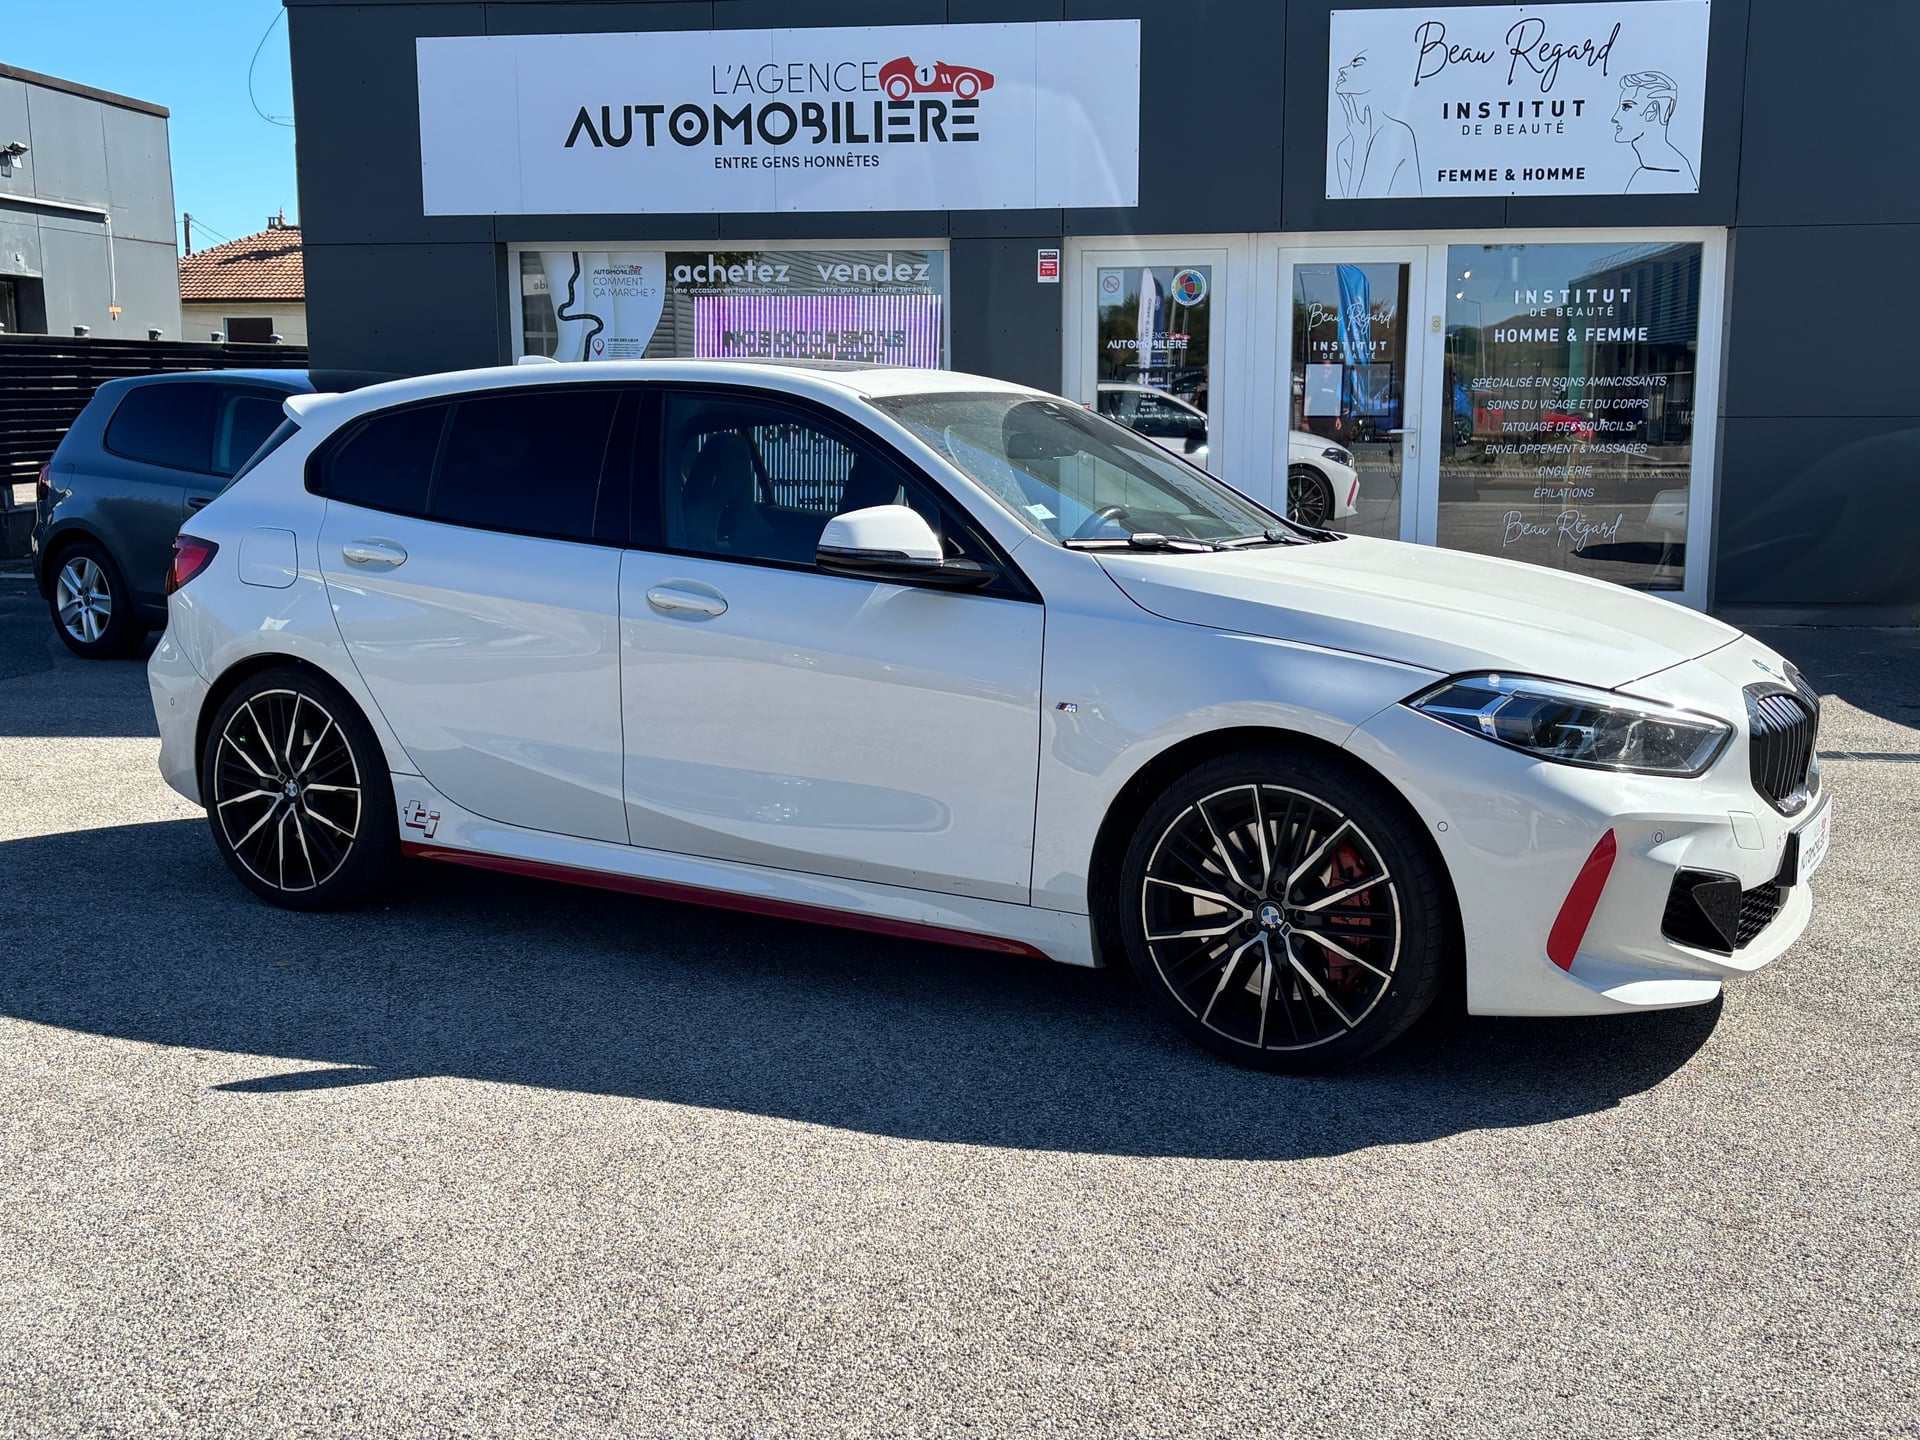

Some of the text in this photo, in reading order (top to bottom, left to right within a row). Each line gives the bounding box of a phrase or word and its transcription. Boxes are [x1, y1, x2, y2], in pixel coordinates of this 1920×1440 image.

[1414, 17, 1621, 93] Beau Regard
[712, 61, 879, 95] L'AGENCE
[921, 67, 928, 82] 1
[1443, 100, 1586, 120] INSTITUT
[1462, 120, 1565, 136] DE BEAUTÉ
[714, 152, 880, 169] ENTRE GENS HONNÊTES
[1437, 167, 1586, 183] FEMME & HOMME
[673, 253, 791, 283] achetez
[816, 252, 931, 282] vendez
[592, 276, 644, 286] COMMENT
[592, 287, 657, 299] ÇA MARCHE ?
[1514, 288, 1631, 304] INSTITUT
[1308, 302, 1395, 334] Beau Regard
[1529, 304, 1614, 317] DE BEAUTÉ
[1494, 327, 1649, 343] HOMME & FEMME
[1313, 341, 1387, 351] INSTITUT
[1471, 376, 1668, 388] SPÉCIALISÉ EN SOINS AMINCISSANTS
[1486, 398, 1650, 410] SOINS DU VISAGE ET DU CORPS
[1502, 420, 1634, 432] TATOUAGE DES SOURCILS
[1484, 443, 1648, 455] ENVELOPPEMENT & MASSAGES
[1538, 465, 1593, 477] ONGLERIE
[1533, 486, 1595, 498] ÉPILATIONS
[1502, 509, 1624, 552] Beau Regard
